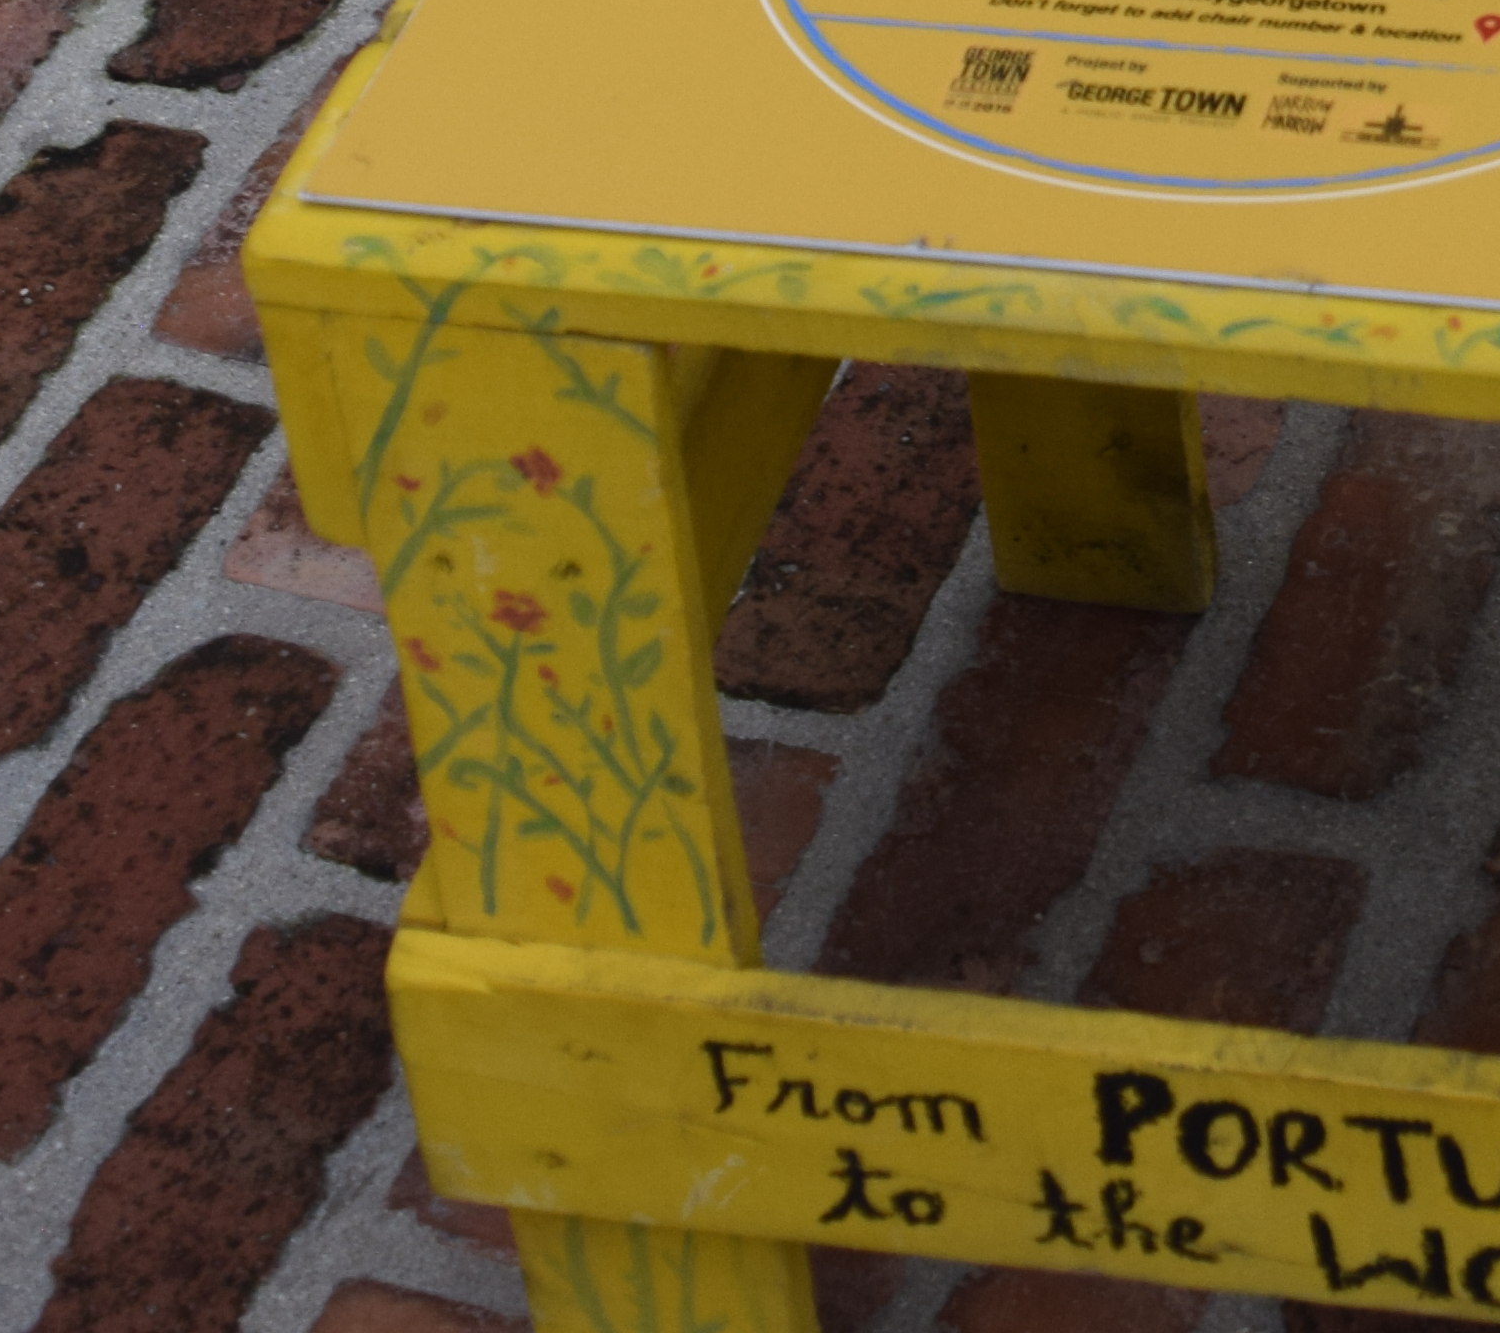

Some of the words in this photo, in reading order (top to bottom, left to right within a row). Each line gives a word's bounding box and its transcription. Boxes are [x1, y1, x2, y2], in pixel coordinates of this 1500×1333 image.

[1123, 4, 1144, 18] to
[1150, 6, 1194, 22] add
[1198, 12, 1254, 27] chair
[1258, 16, 1343, 35] number
[1350, 23, 1366, 36] &
[1372, 25, 1463, 43] location
[959, 60, 1031, 83] TOWN
[1065, 54, 1125, 72] Project
[1130, 62, 1147, 73] by
[1278, 71, 1364, 92] Supported
[1367, 79, 1387, 94] by
[1068, 83, 1153, 106] GEORGE
[1159, 87, 1247, 117] TOWN
[701, 1039, 987, 1143] From
[820, 1146, 945, 1226] to
[1033, 1167, 1224, 1264] the
